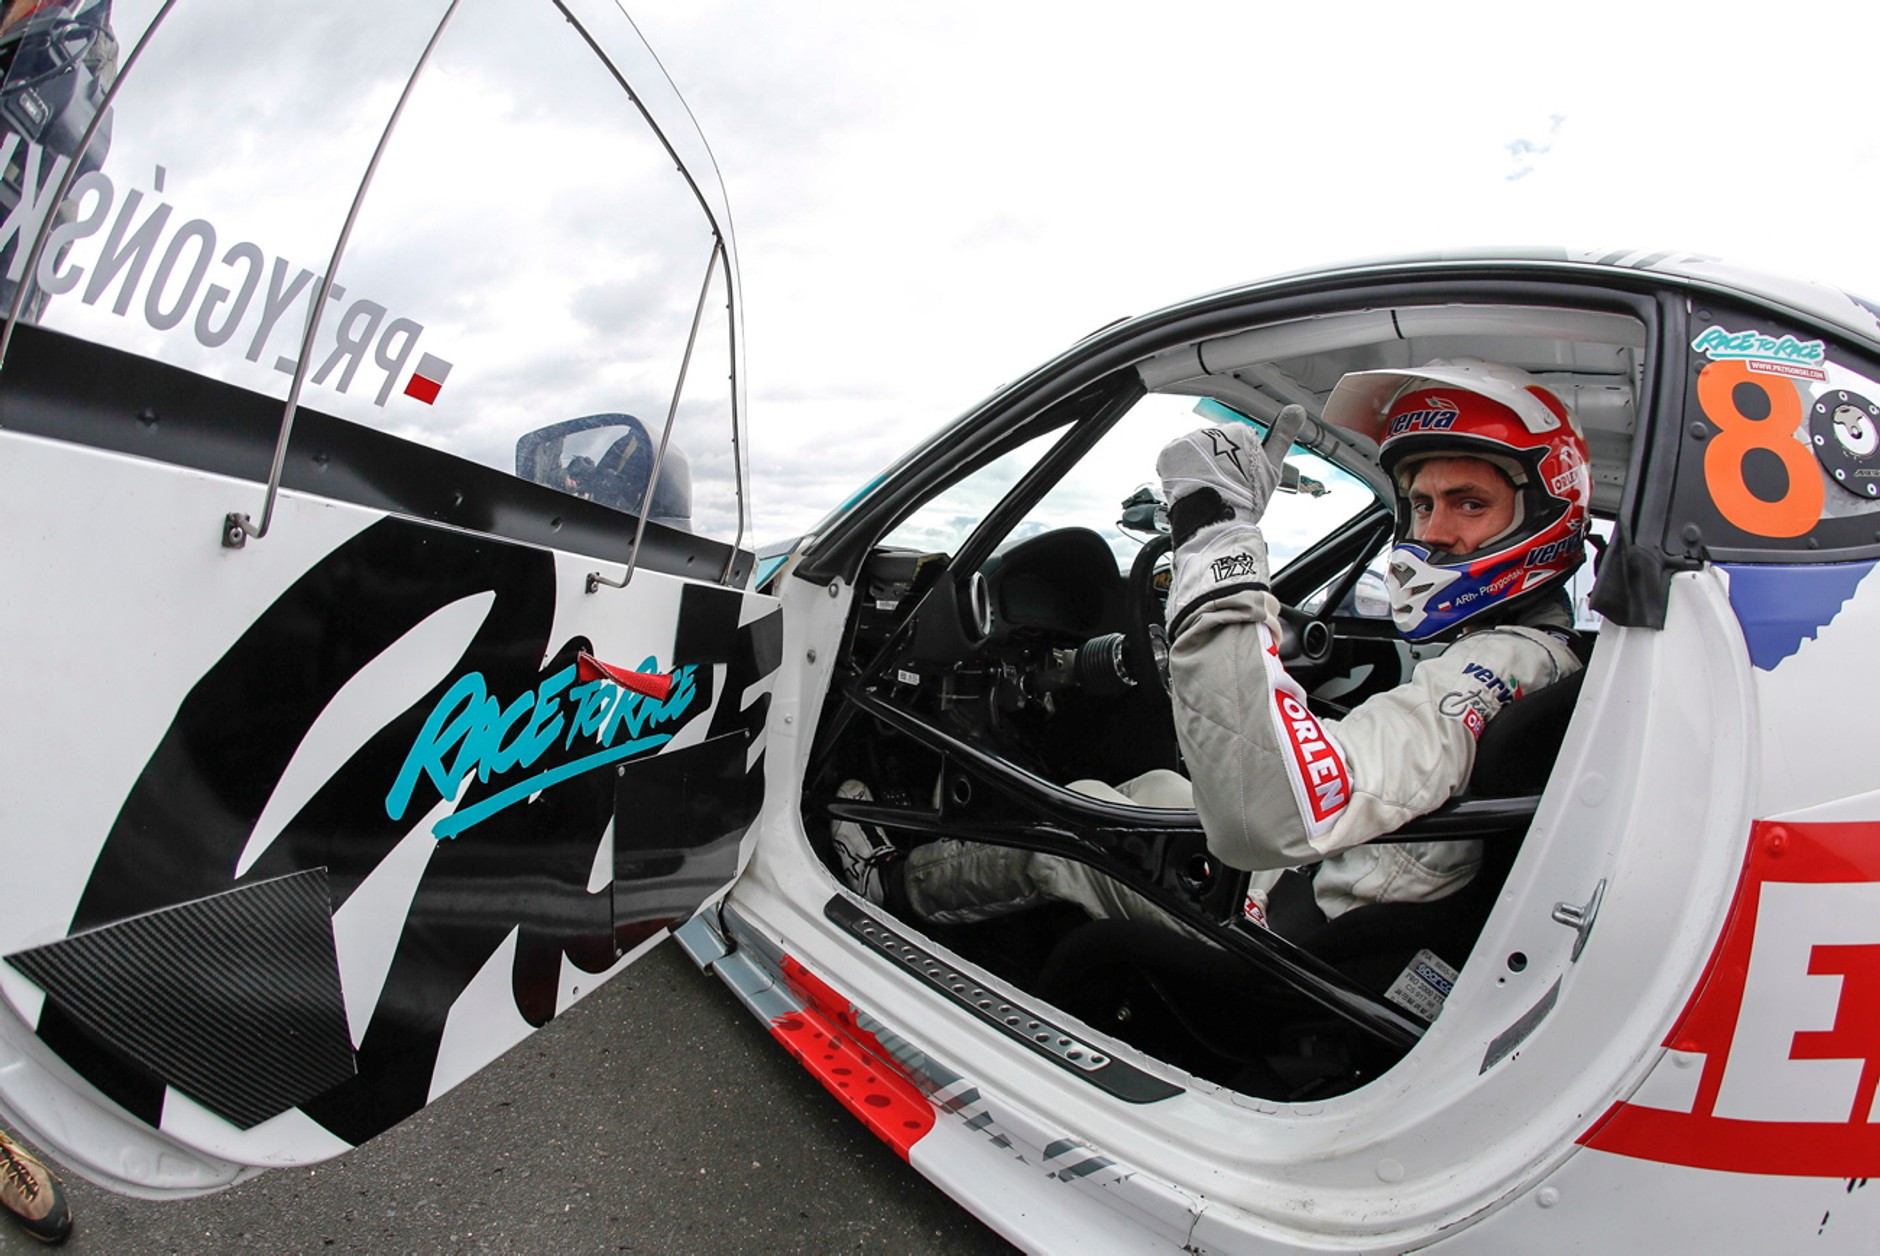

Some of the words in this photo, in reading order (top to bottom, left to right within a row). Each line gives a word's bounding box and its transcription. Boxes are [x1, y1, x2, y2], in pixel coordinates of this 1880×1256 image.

[1695, 329, 1757, 351] RACE
[1754, 337, 1777, 352] TO
[1773, 337, 1822, 360] RACE
[1386, 408, 1459, 438] verva
[1697, 360, 1824, 538] 8
[1462, 663, 1514, 703] verv
[385, 664, 577, 820] RACE
[566, 680, 618, 751] TO
[602, 655, 700, 748] RACE
[1283, 697, 1345, 812] ORLEN
